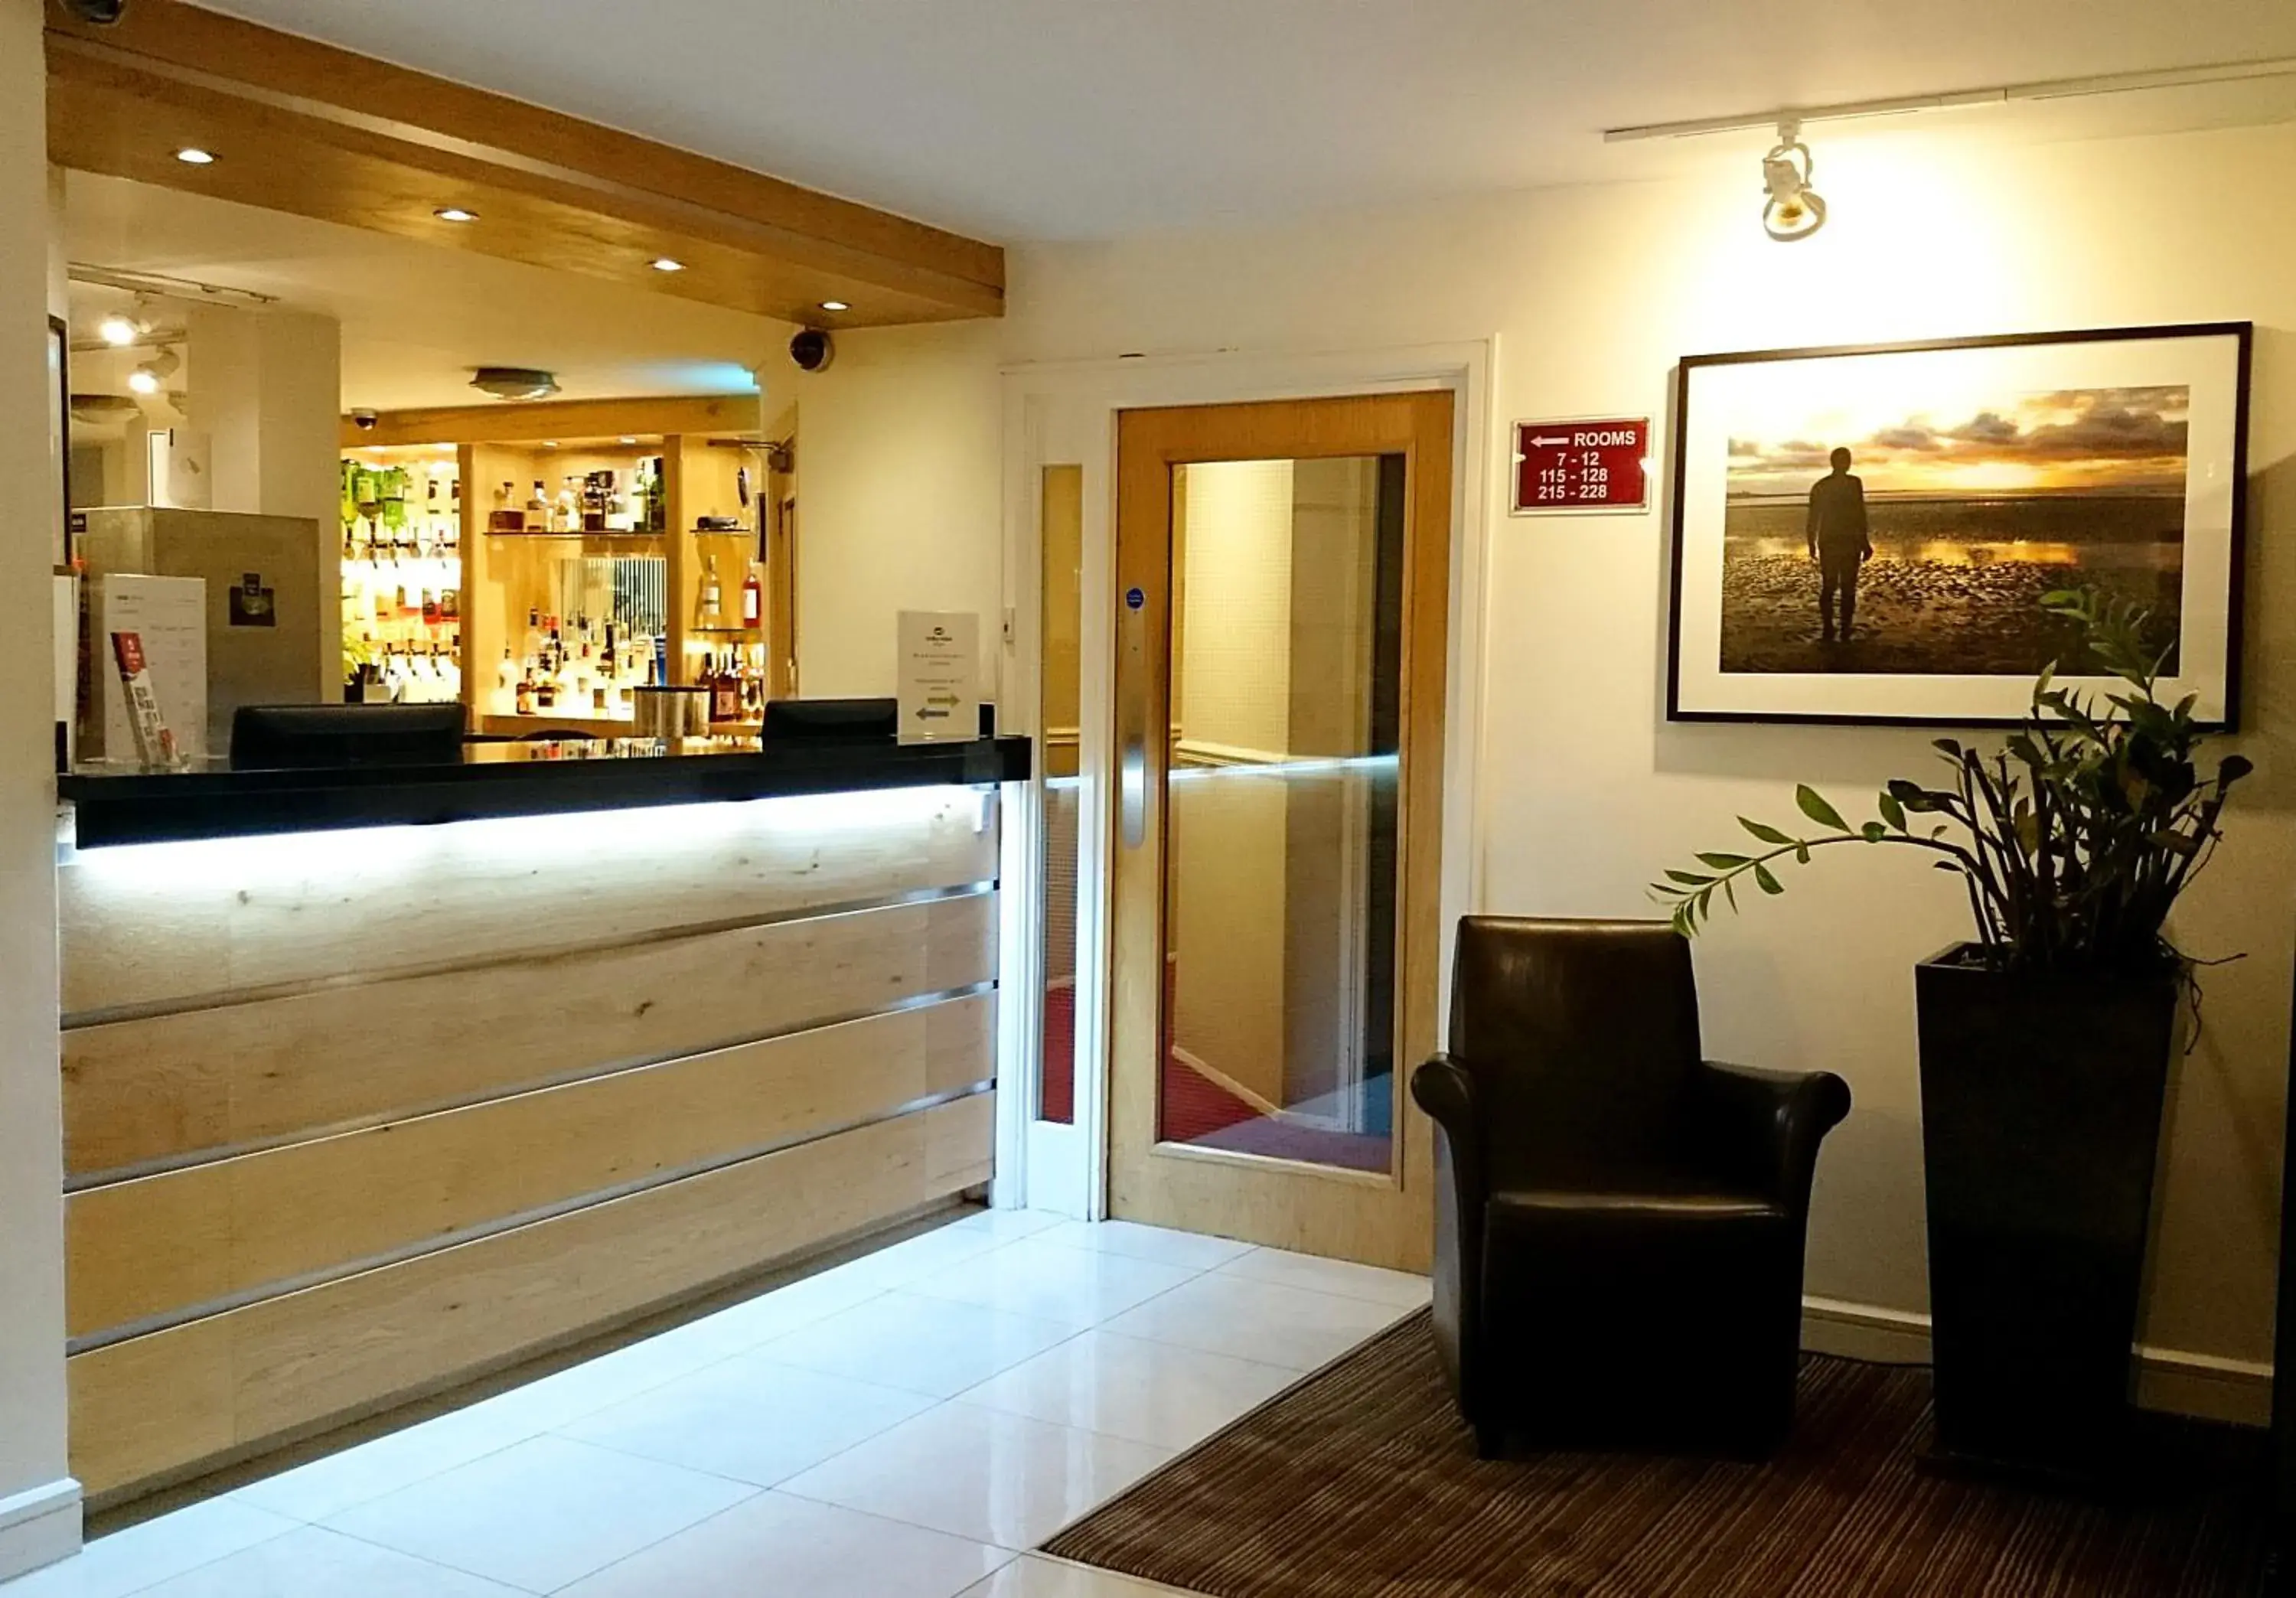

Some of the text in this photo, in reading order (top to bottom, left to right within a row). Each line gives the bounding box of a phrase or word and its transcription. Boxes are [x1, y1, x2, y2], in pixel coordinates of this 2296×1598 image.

[1574, 431, 1636, 447] ROOMS
[1557, 452, 1567, 466] 7
[1582, 452, 1600, 465] 12
[1539, 469, 1566, 483] 115
[1580, 468, 1608, 482] 128
[1538, 485, 1565, 499] 215
[1580, 484, 1607, 498] 228
